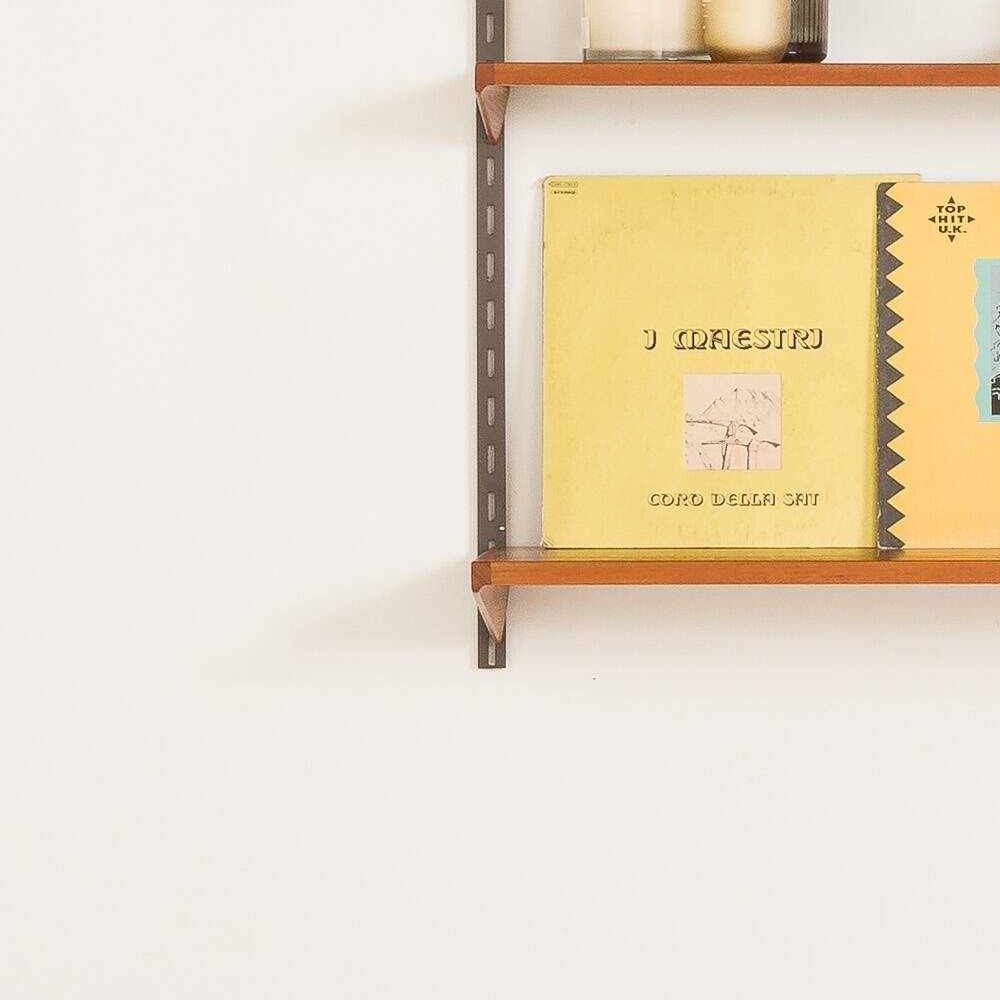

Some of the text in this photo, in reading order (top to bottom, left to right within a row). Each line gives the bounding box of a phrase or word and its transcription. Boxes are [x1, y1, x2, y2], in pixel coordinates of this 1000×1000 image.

[936, 205, 967, 214] TOP
[938, 215, 965, 223] HIT
[938, 225, 967, 234] U.K.
[648, 492, 820, 507] CORO DELLA SAT
